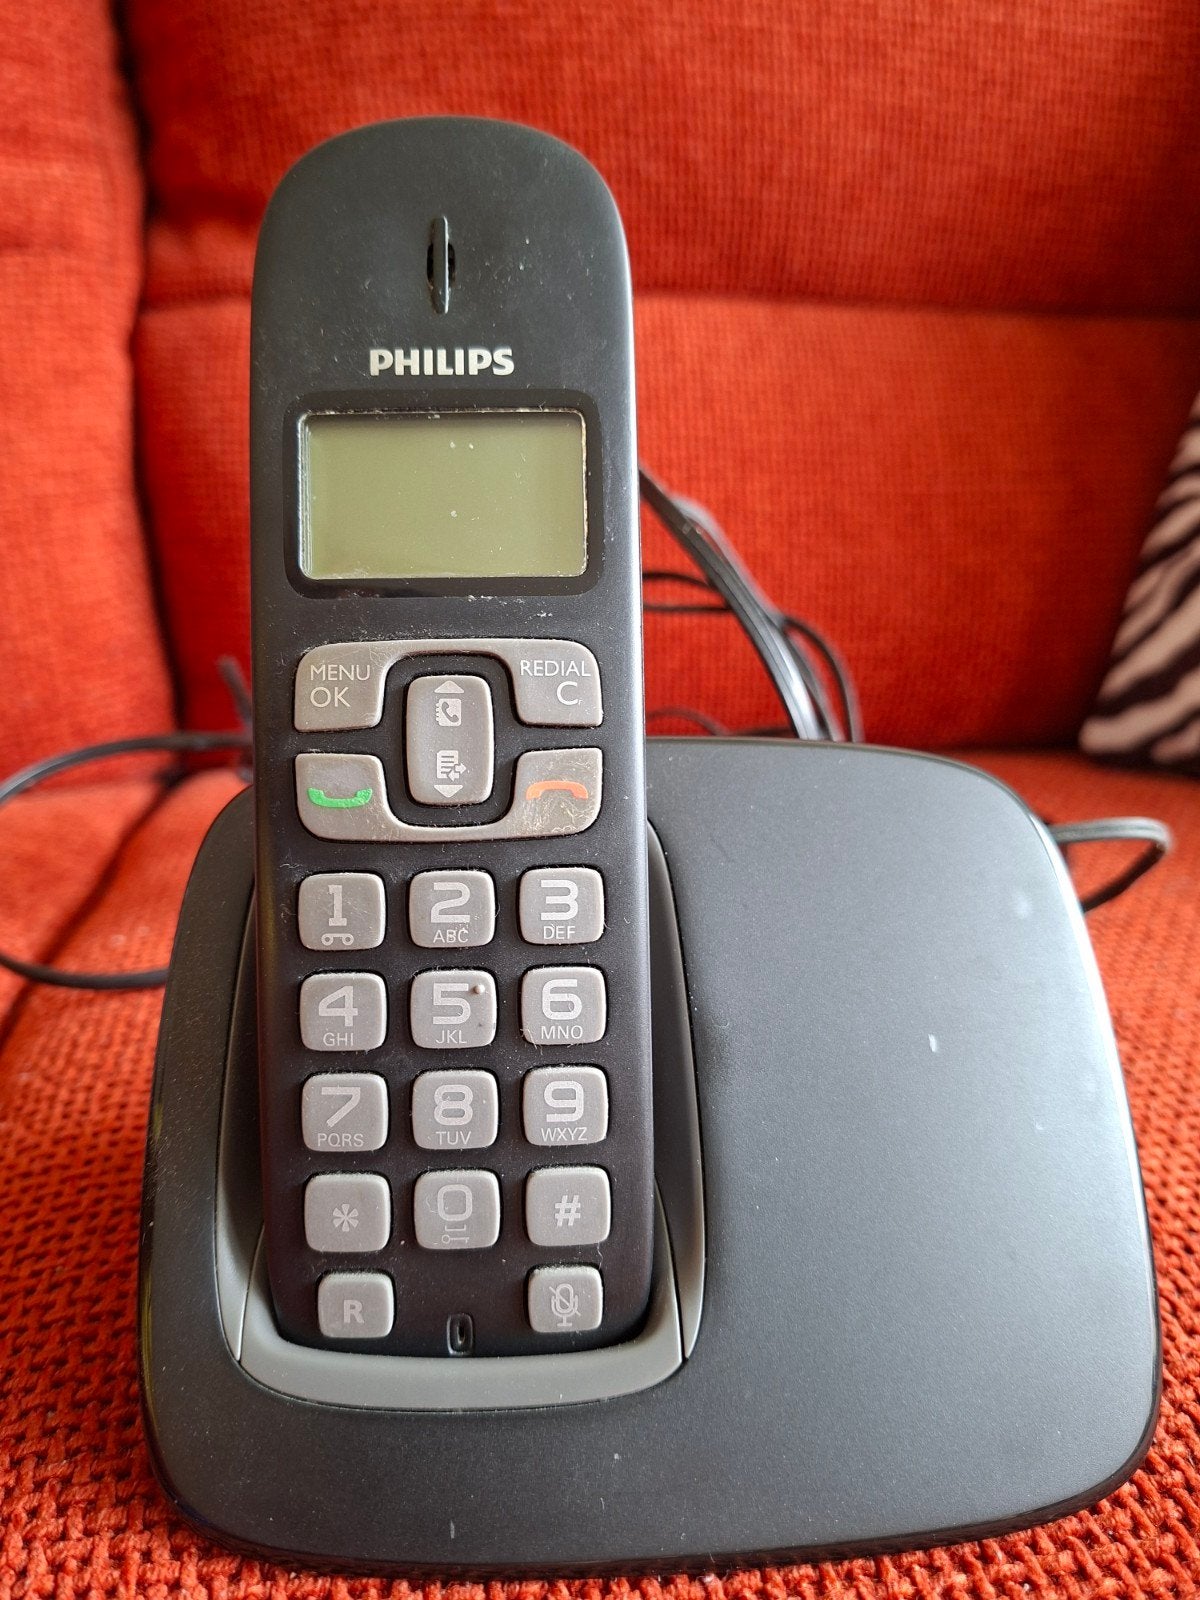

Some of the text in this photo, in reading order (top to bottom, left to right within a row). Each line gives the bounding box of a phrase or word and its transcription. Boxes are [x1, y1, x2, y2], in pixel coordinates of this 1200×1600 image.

[369, 347, 515, 376] PHILIPS
[310, 664, 371, 681] MENU
[519, 659, 591, 678] REDIAL
[310, 686, 351, 708] OK
[556, 681, 580, 706] C
[327, 884, 347, 926] 1
[430, 881, 471, 923] 2
[540, 879, 579, 921] 3
[433, 929, 469, 943] ABC
[543, 925, 576, 939] DEF
[318, 985, 358, 1027] 4
[432, 982, 471, 1025] 5
[541, 979, 583, 1020] 6
[323, 1032, 354, 1046] GHI
[435, 1030, 467, 1044] JKL
[541, 1025, 583, 1040] MNO
[321, 1087, 361, 1128] 7
[434, 1084, 473, 1125] 8
[543, 1080, 584, 1122] 9
[317, 1133, 364, 1147] PQRS
[436, 1131, 472, 1145] TUV
[541, 1127, 588, 1142] WXYZ
[437, 1184, 473, 1221] 0
[554, 1195, 581, 1227] #
[343, 1300, 365, 1324] R
